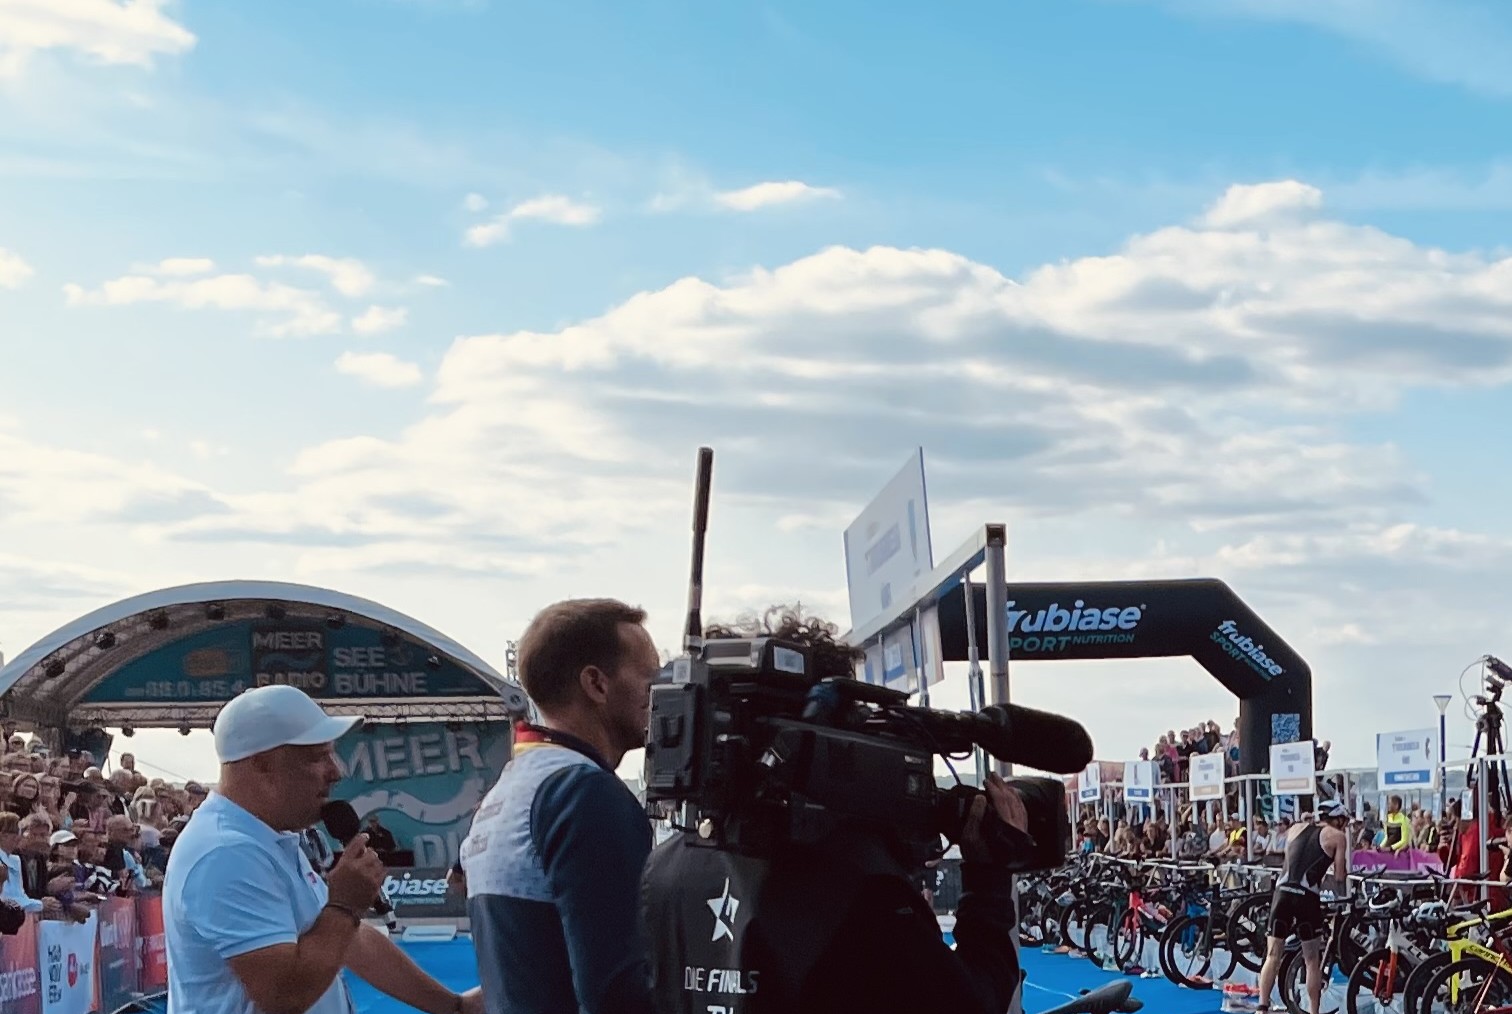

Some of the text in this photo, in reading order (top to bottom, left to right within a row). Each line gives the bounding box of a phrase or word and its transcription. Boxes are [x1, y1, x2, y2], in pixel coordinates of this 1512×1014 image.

[1007, 600, 1144, 633] frubiase
[252, 631, 324, 650] MEER
[1008, 633, 1135, 652] PORT NUTRITION
[1217, 619, 1283, 677] frubiase
[333, 646, 386, 668] SEE
[256, 672, 326, 690] RADIO
[334, 669, 428, 694] BÜHNE
[335, 730, 484, 783] MEER
[382, 872, 449, 896] biase
[684, 966, 704, 991] DIE
